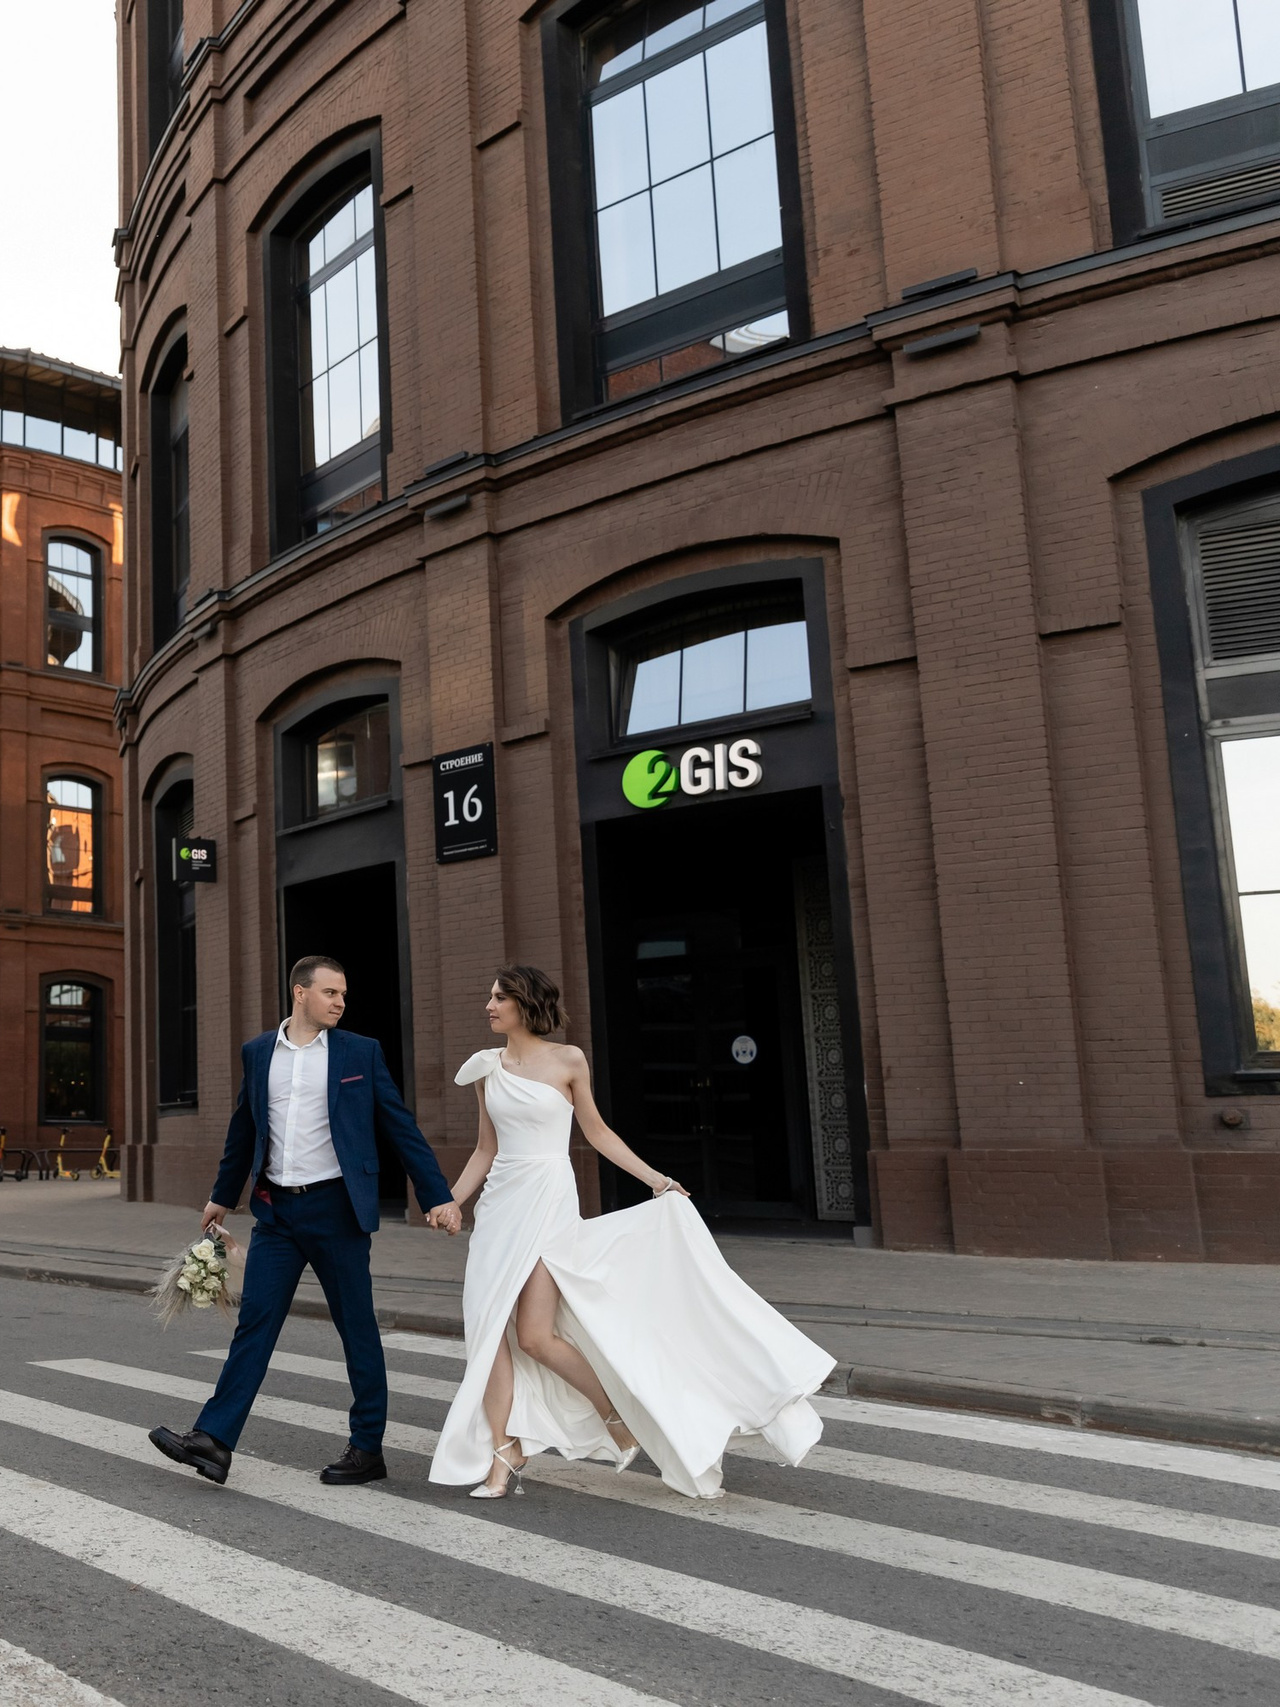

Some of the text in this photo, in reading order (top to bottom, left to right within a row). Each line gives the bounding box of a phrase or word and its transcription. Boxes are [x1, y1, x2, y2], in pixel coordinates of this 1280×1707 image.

[440, 752, 484, 771] СТРОЕНИЕ
[622, 739, 763, 809] 2GIS
[443, 784, 483, 827] 16
